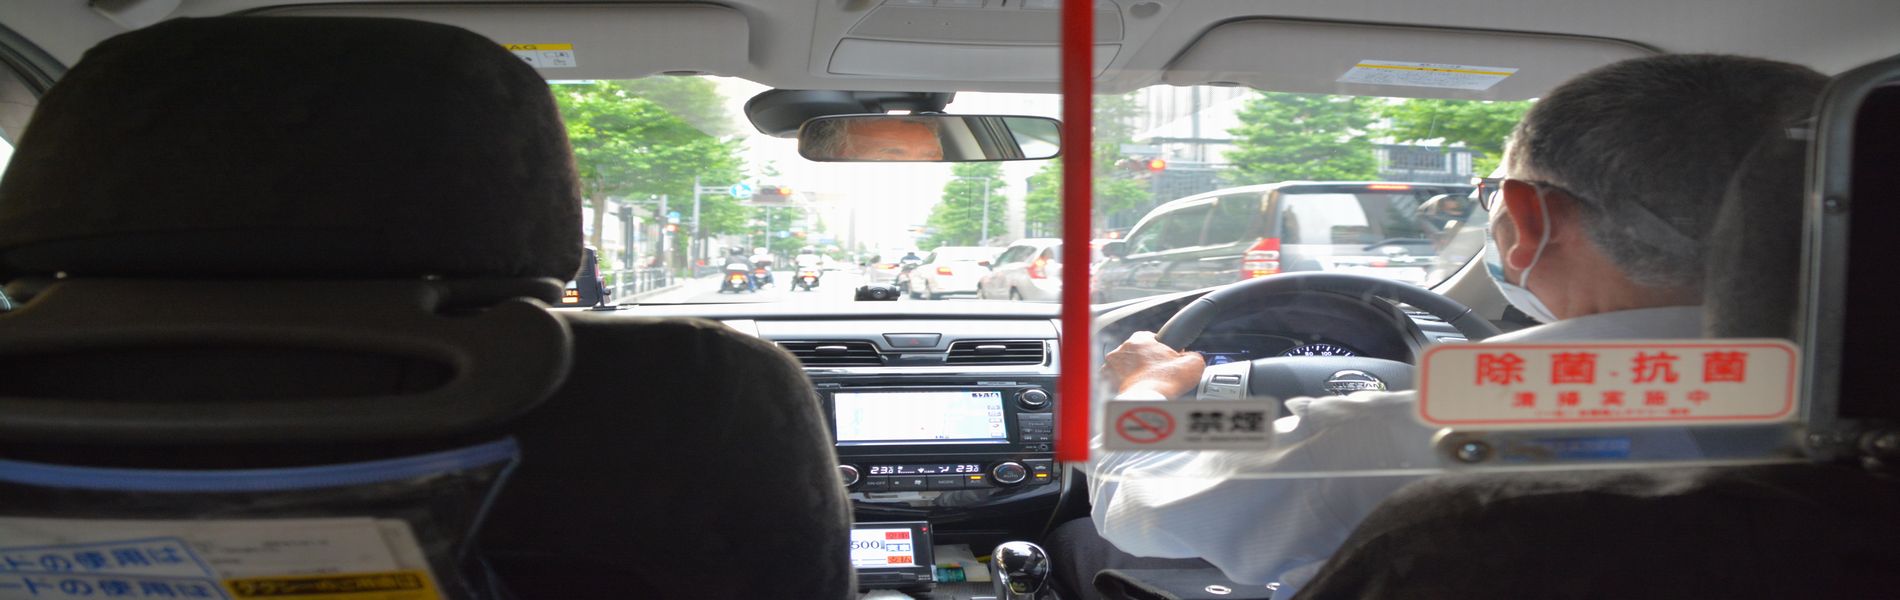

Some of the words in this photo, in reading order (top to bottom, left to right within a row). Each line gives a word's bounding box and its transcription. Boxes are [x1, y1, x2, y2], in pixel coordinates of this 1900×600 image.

[1512, 389, 1711, 408] 清掃実施中
[1188, 409, 1265, 435] 禁煙
